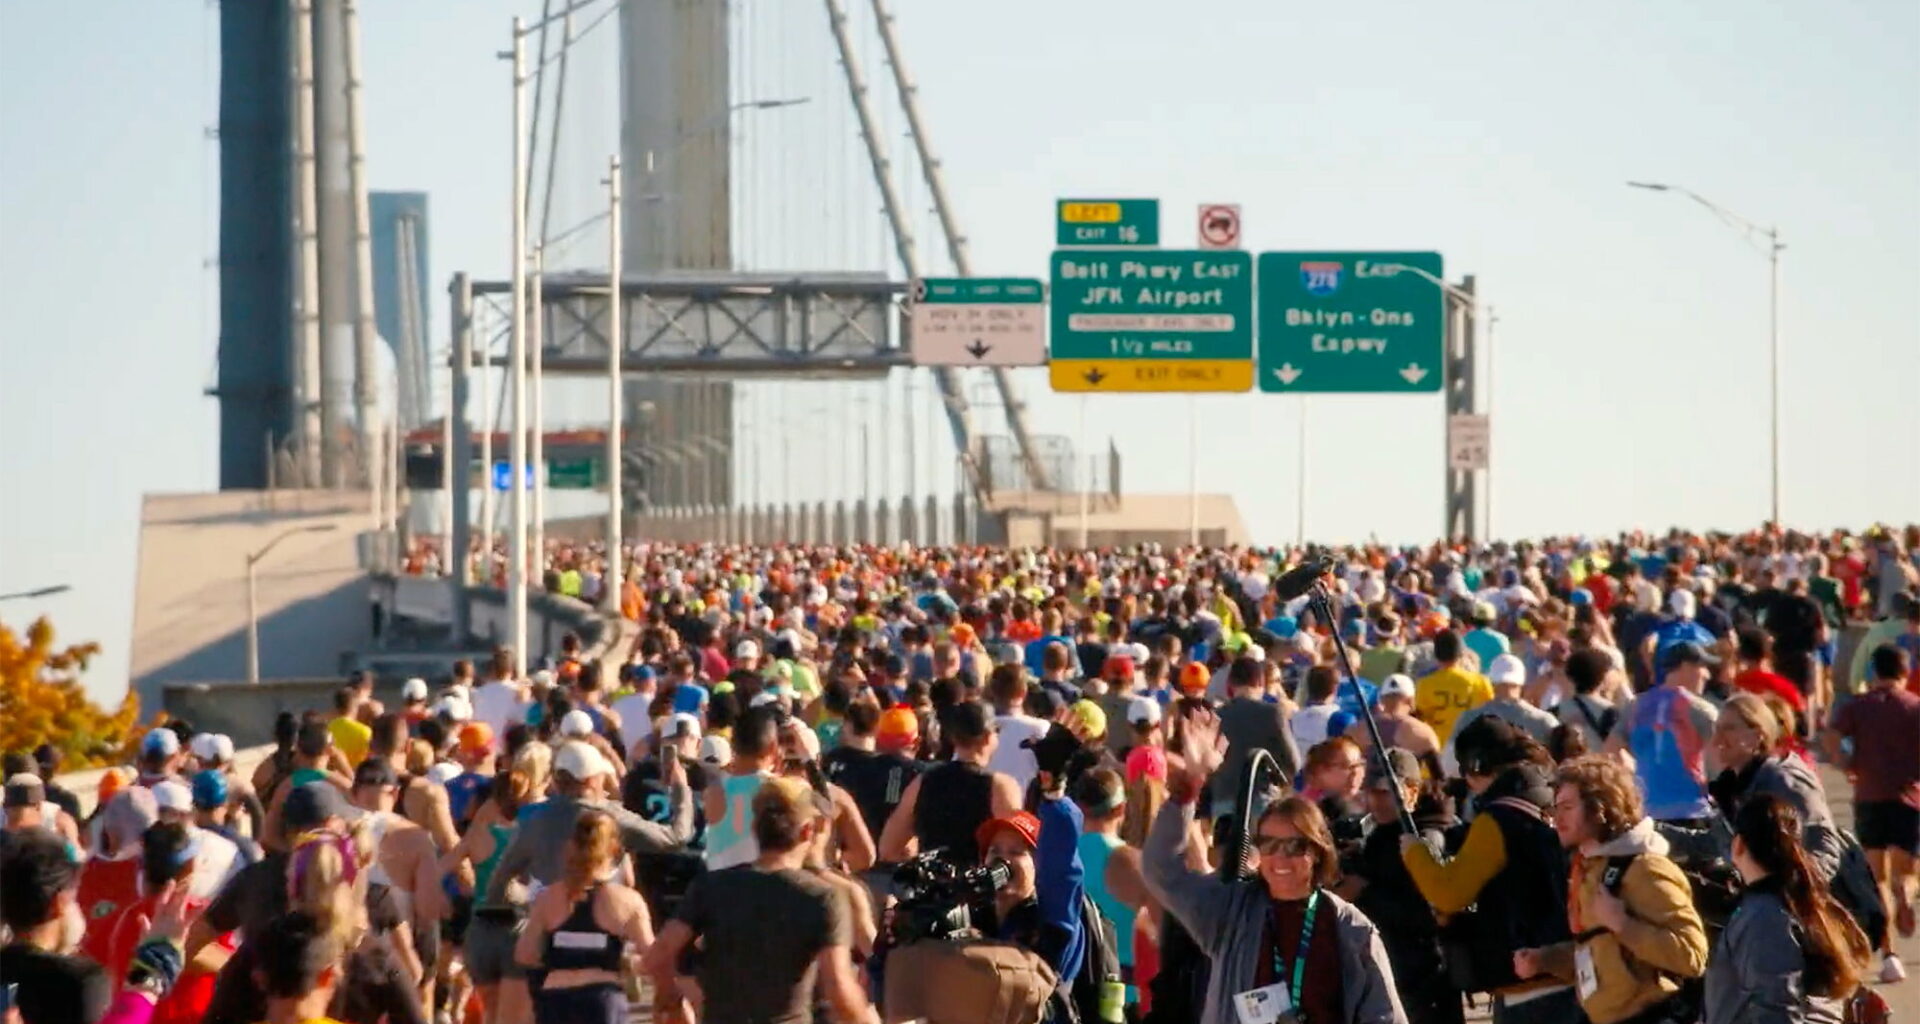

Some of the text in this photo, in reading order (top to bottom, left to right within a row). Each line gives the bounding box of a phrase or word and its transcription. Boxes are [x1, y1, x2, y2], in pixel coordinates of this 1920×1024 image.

[1076, 226, 1140, 243] EXIT 16
[1061, 261, 1108, 279] Belt
[1120, 261, 1182, 281] Pkwy
[1306, 271, 1338, 290] 278
[1082, 287, 1223, 308] JFK Airport
[1135, 367, 1222, 381] EXIT ONLY
